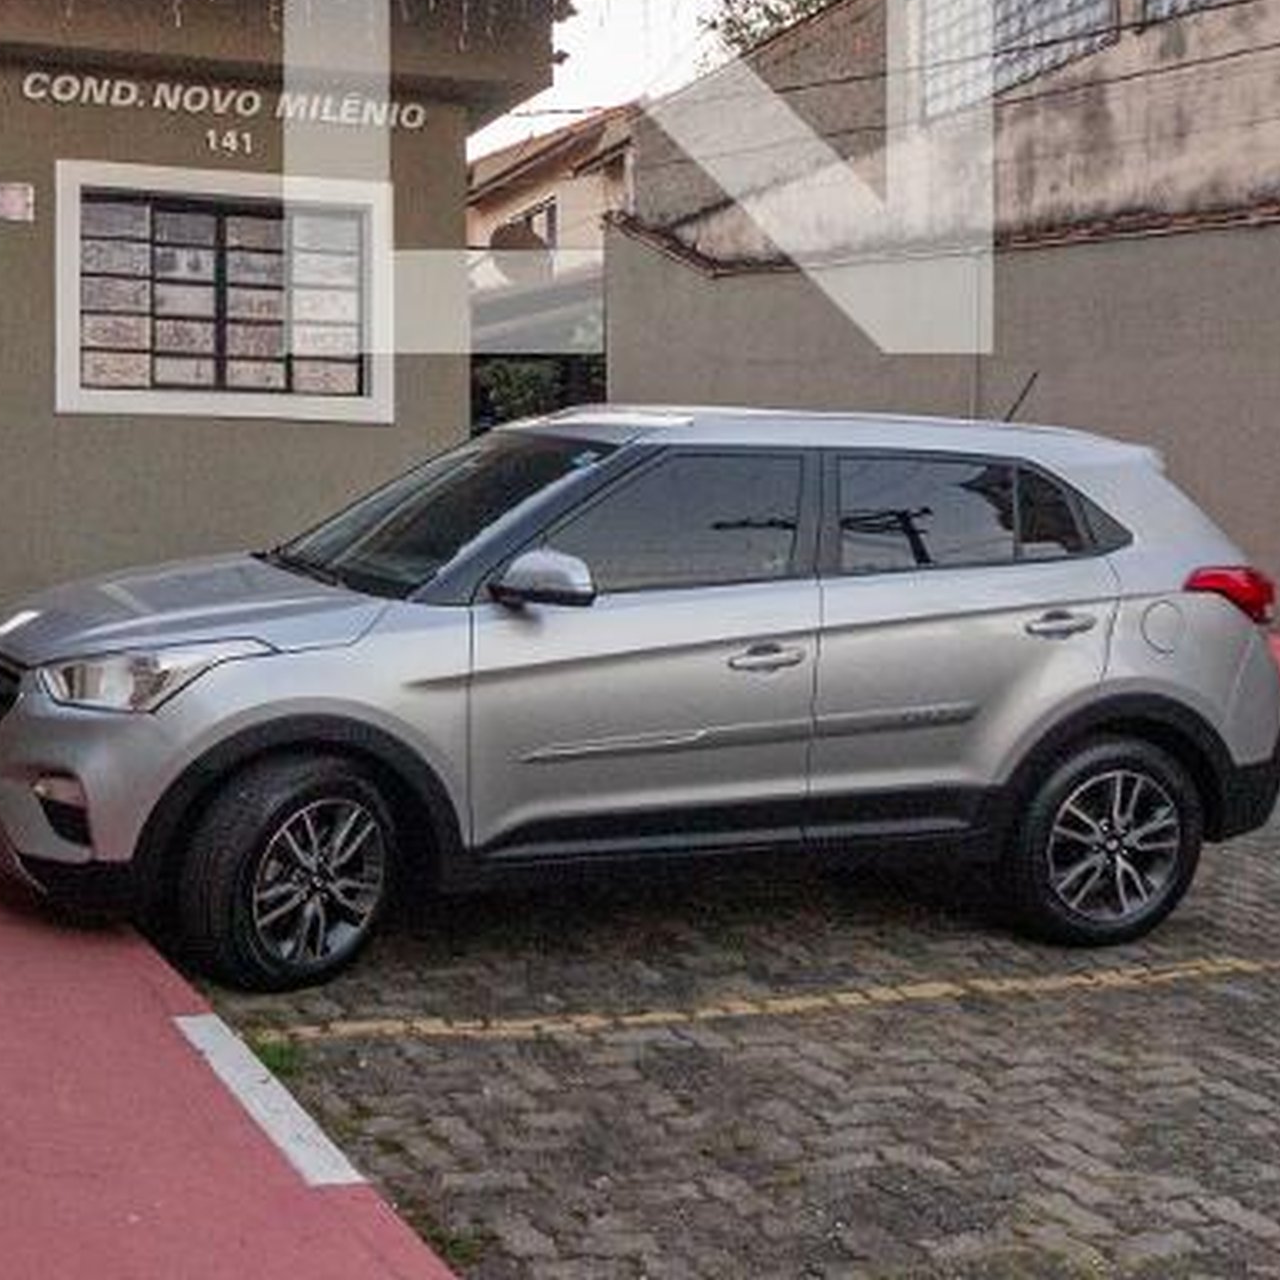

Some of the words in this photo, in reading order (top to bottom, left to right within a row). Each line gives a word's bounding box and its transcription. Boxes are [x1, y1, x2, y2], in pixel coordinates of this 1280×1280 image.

[22, 73, 146, 108] COND.
[153, 84, 262, 117] NOVO
[205, 129, 254, 154] 141
